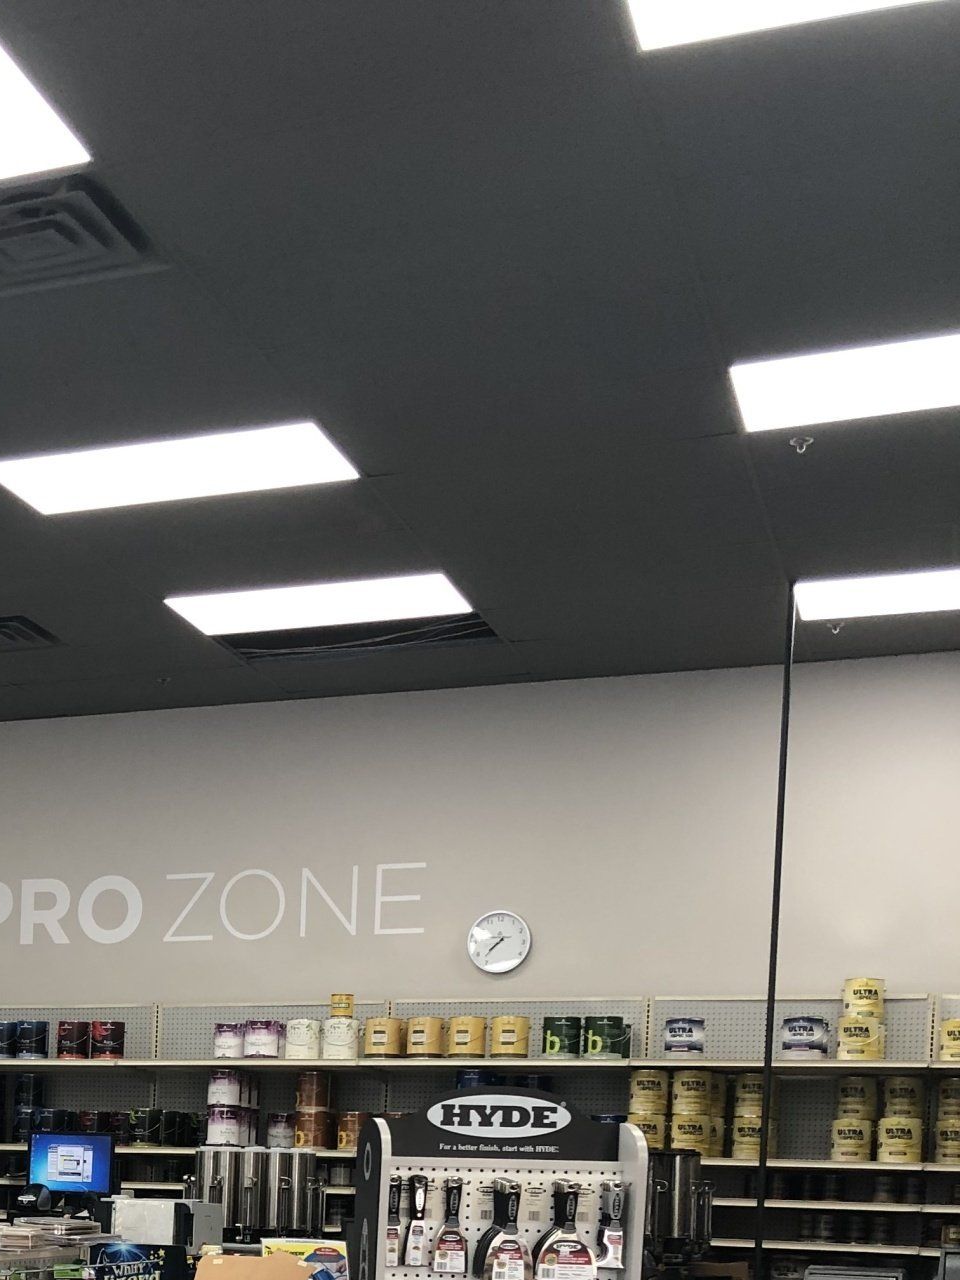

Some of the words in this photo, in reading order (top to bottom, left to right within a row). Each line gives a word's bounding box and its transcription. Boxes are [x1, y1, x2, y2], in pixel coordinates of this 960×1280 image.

[163, 861, 427, 943] ZONE
[843, 1026, 869, 1034] ULTRA
[441, 1104, 558, 1128] HYDE
